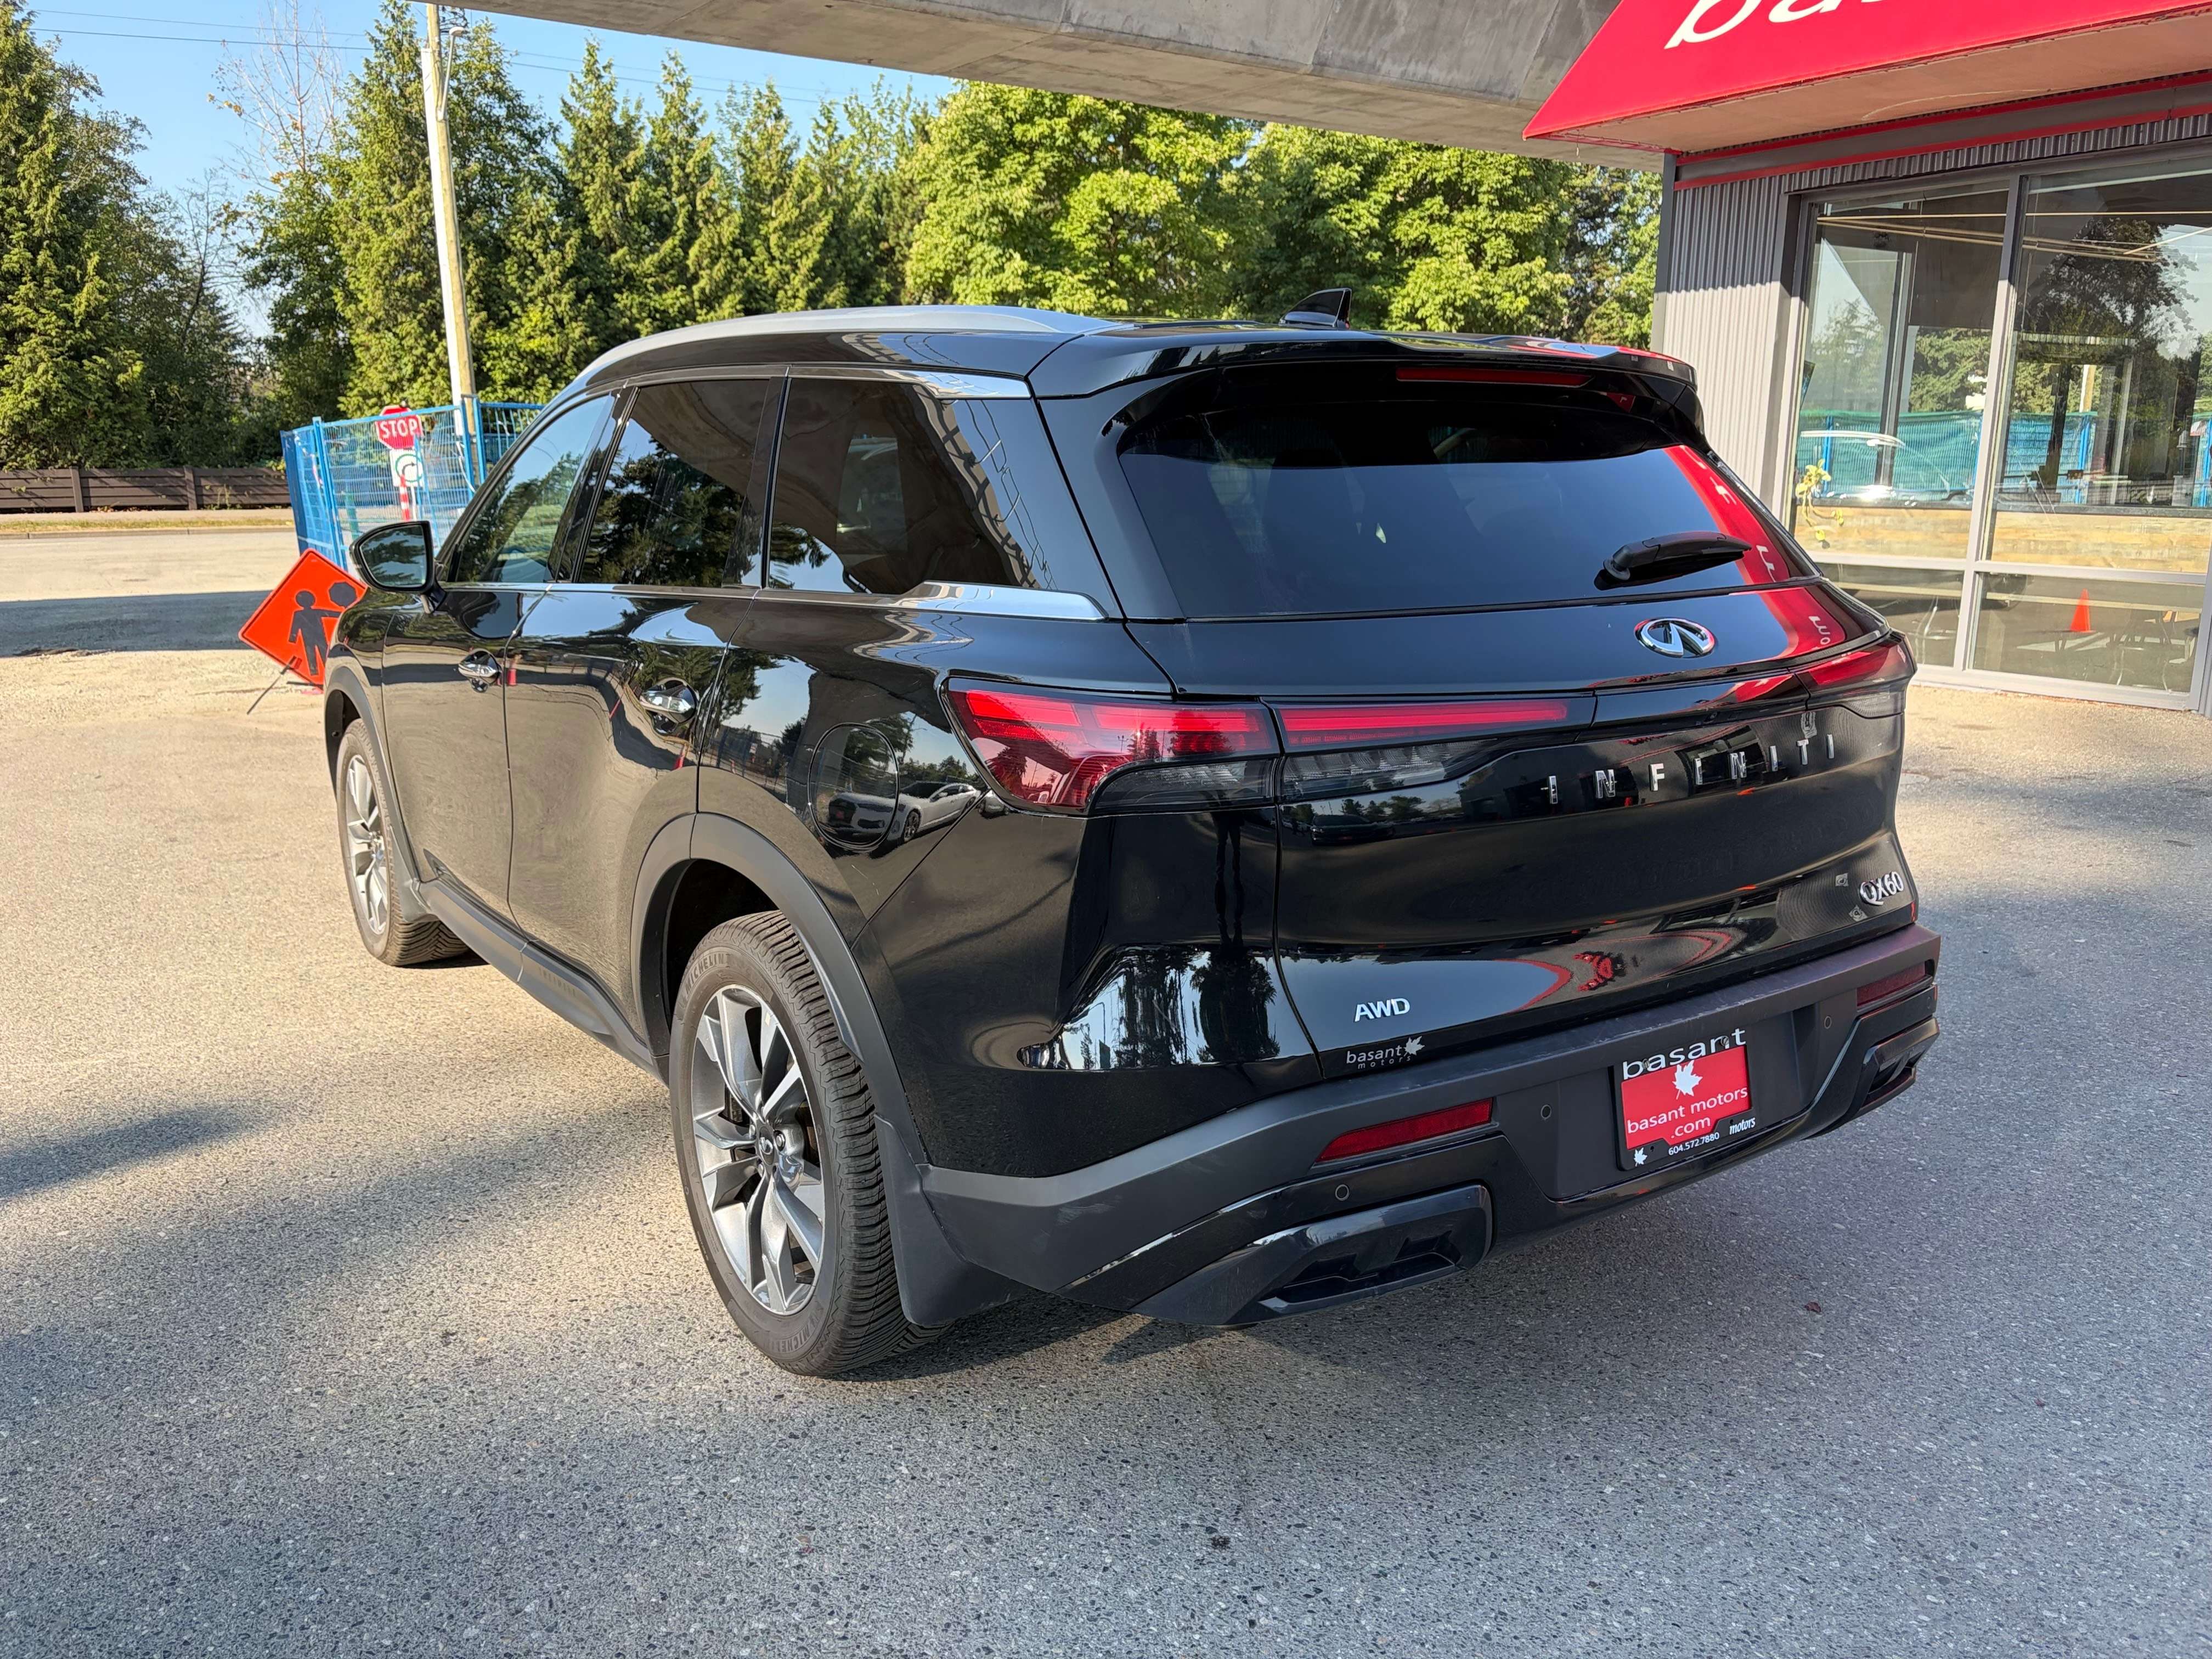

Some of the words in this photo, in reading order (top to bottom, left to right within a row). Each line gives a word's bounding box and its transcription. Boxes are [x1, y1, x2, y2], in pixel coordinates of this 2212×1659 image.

[380, 418, 417, 438] STOP
[1547, 733, 1835, 805] INFINITI
[1859, 871, 1904, 906] QX60
[1354, 998, 1410, 1022] AWD
[1346, 1045, 1402, 1064] basant
[1358, 1054, 1412, 1070] motors
[1622, 1028, 1746, 1080] basant
[1627, 1105, 1686, 1134] basant
[1690, 1087, 1748, 1114] motors
[1671, 1116, 1711, 1139] .com
[1729, 1117, 1756, 1135] motors
[1668, 1131, 1720, 1156] 604.572.7880
